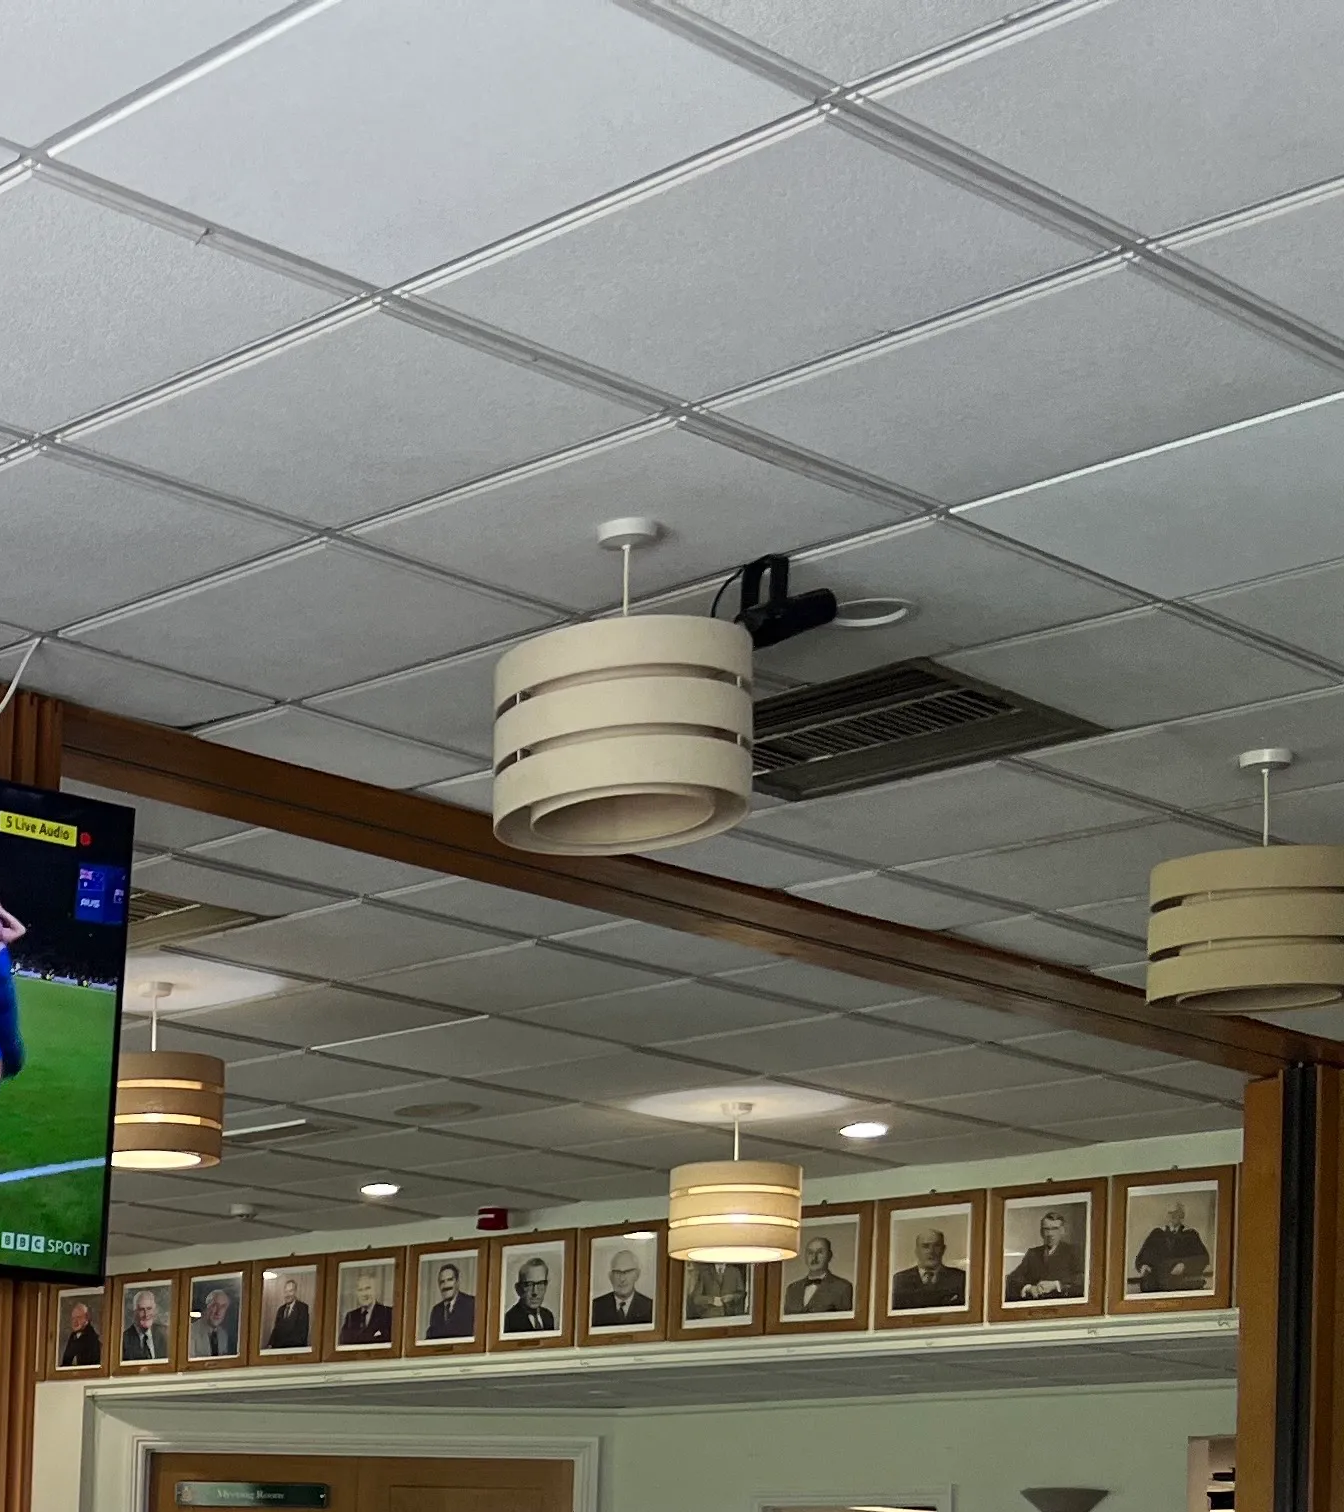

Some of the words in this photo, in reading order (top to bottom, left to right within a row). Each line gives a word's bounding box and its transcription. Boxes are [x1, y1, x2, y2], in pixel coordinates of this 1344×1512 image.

[15, 818, 37, 834] Live
[39, 823, 70, 840] Audio
[2, 1232, 44, 1252] BBC
[47, 1239, 91, 1257] SPORT
